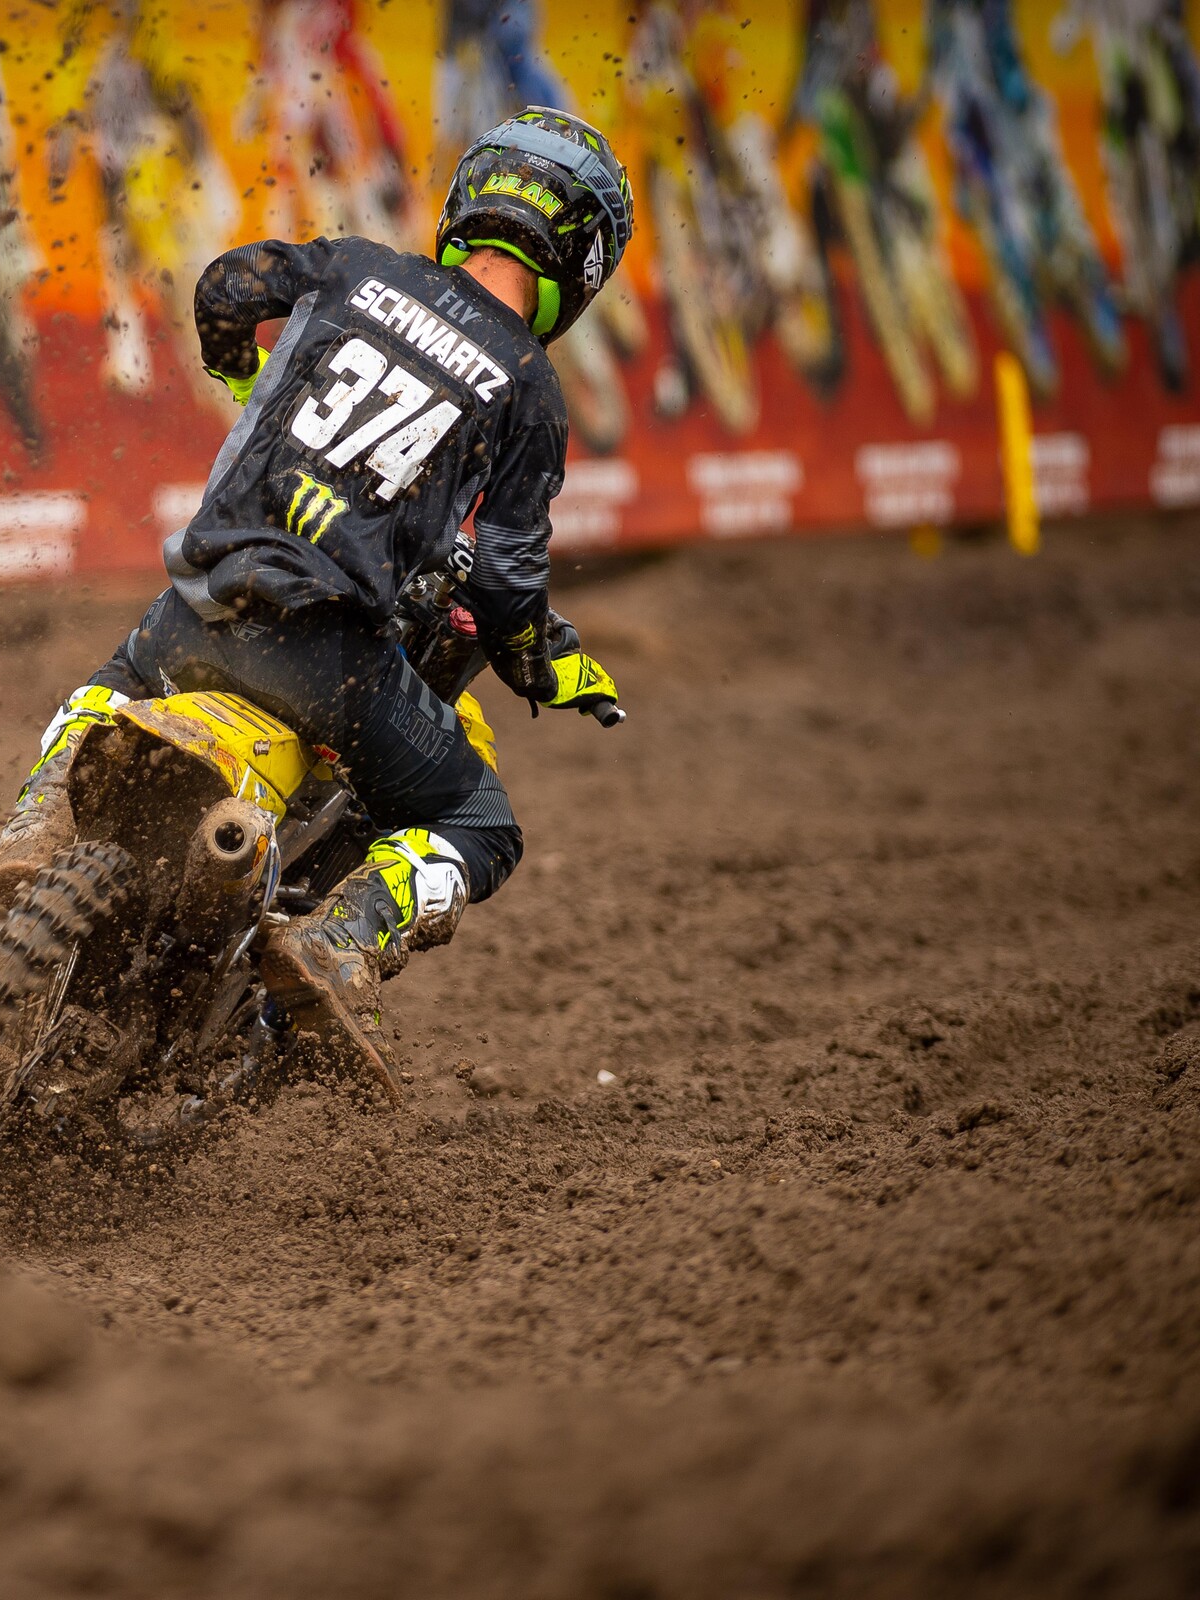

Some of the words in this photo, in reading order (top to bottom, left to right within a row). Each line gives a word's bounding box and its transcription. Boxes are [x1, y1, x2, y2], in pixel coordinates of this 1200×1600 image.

[481, 173, 562, 218] DILAN
[350, 279, 510, 403] SCHWARTZ
[434, 289, 481, 326] FLY
[291, 338, 463, 501] 374
[388, 690, 455, 764] RACING
